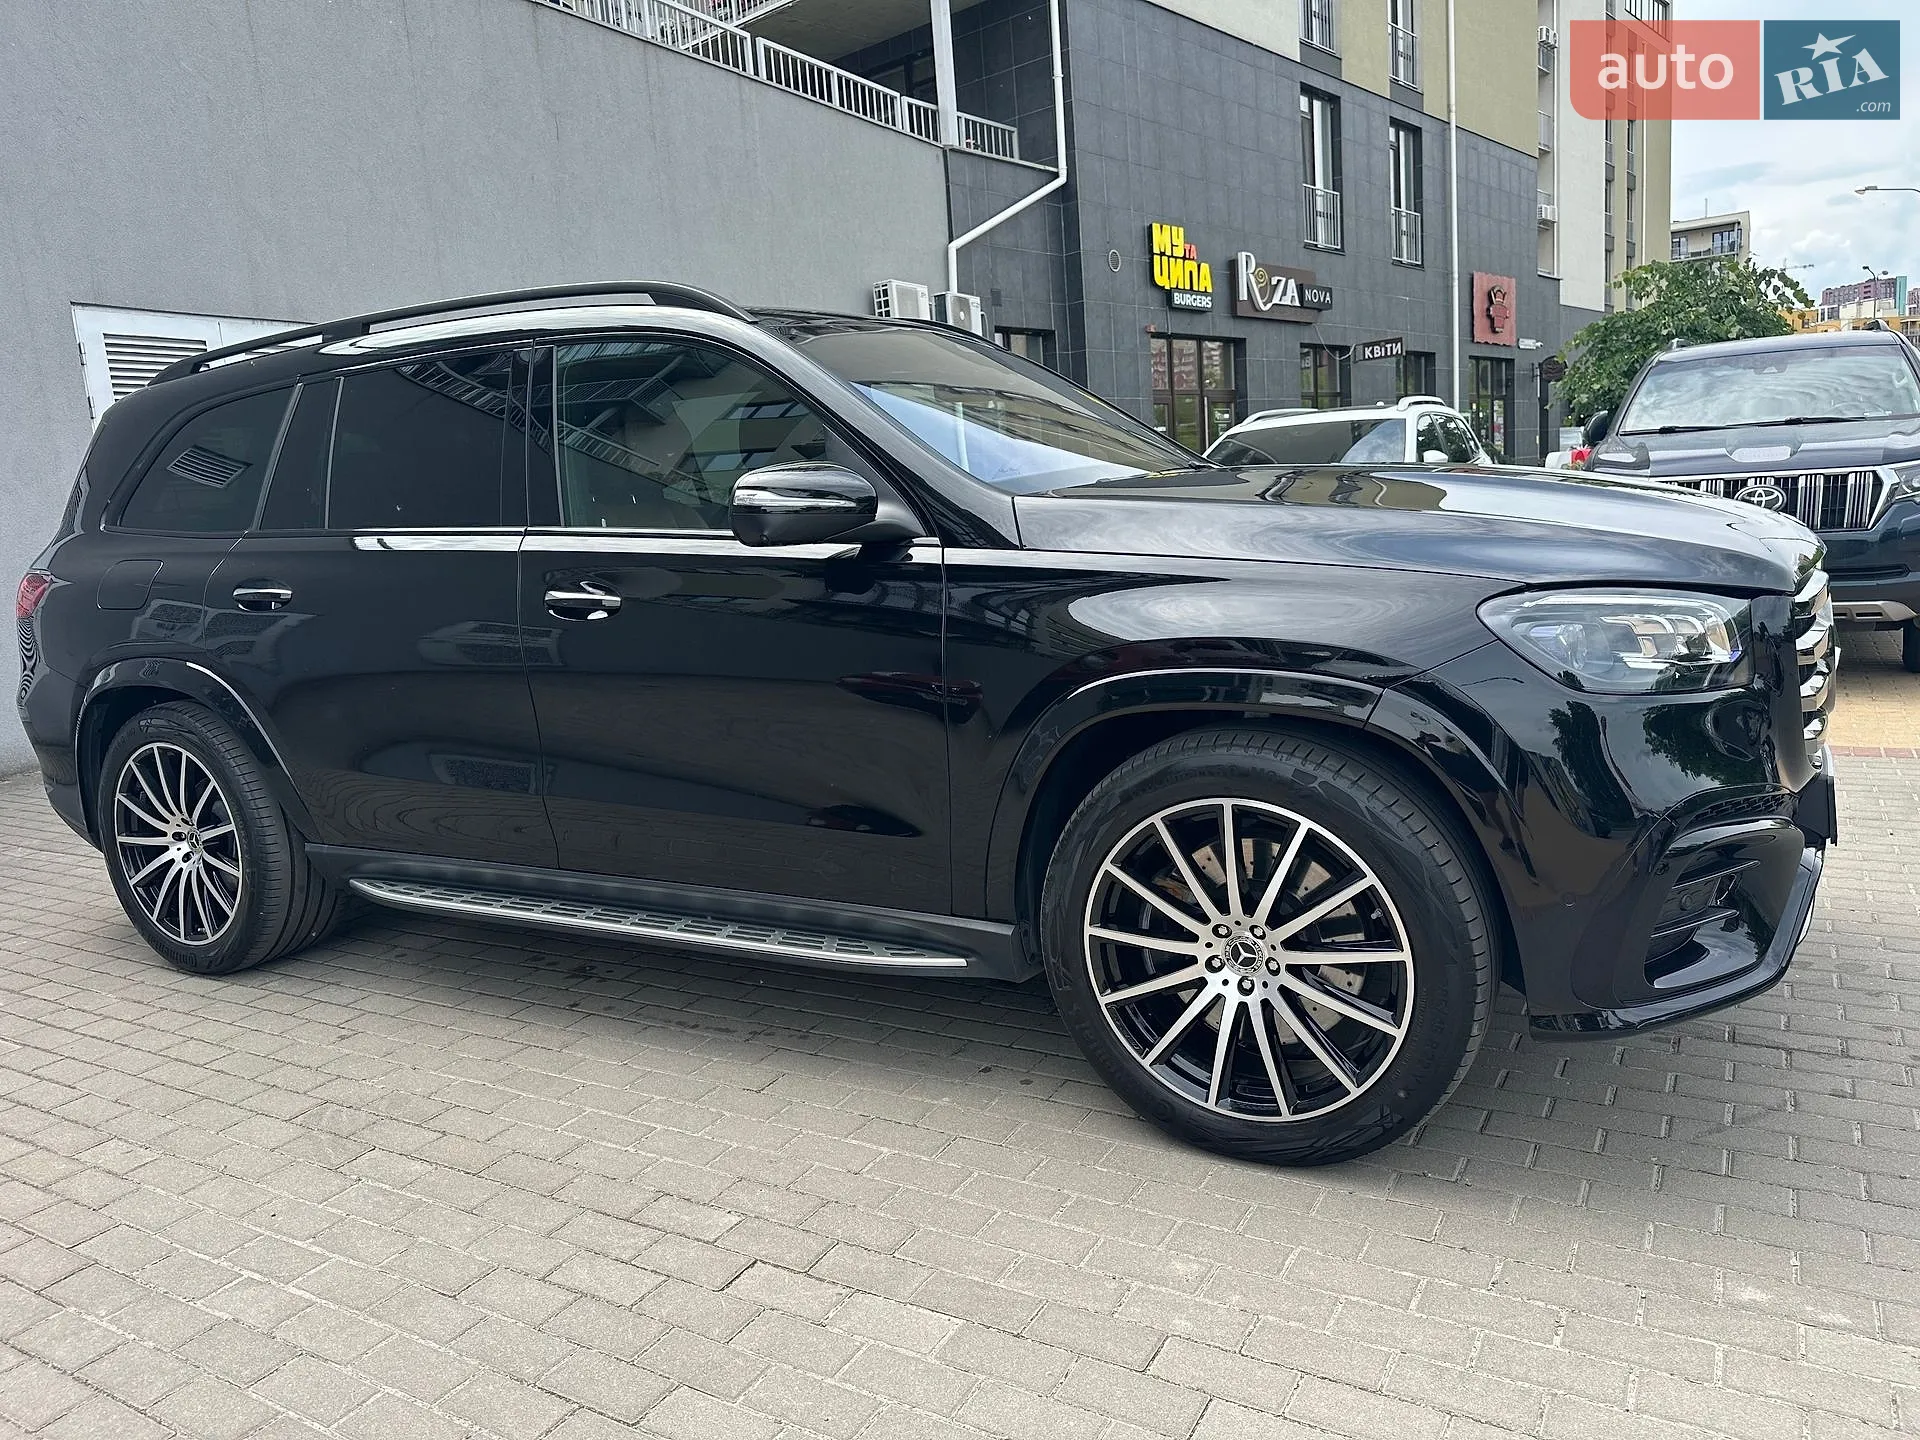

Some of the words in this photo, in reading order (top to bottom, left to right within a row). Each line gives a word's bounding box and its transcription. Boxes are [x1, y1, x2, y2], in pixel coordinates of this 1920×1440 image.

[1151, 222, 1185, 258] МУ
[1153, 254, 1213, 293] ЦИПА
[1173, 292, 1213, 308] BURGERS
[1304, 288, 1332, 305] NOVA
